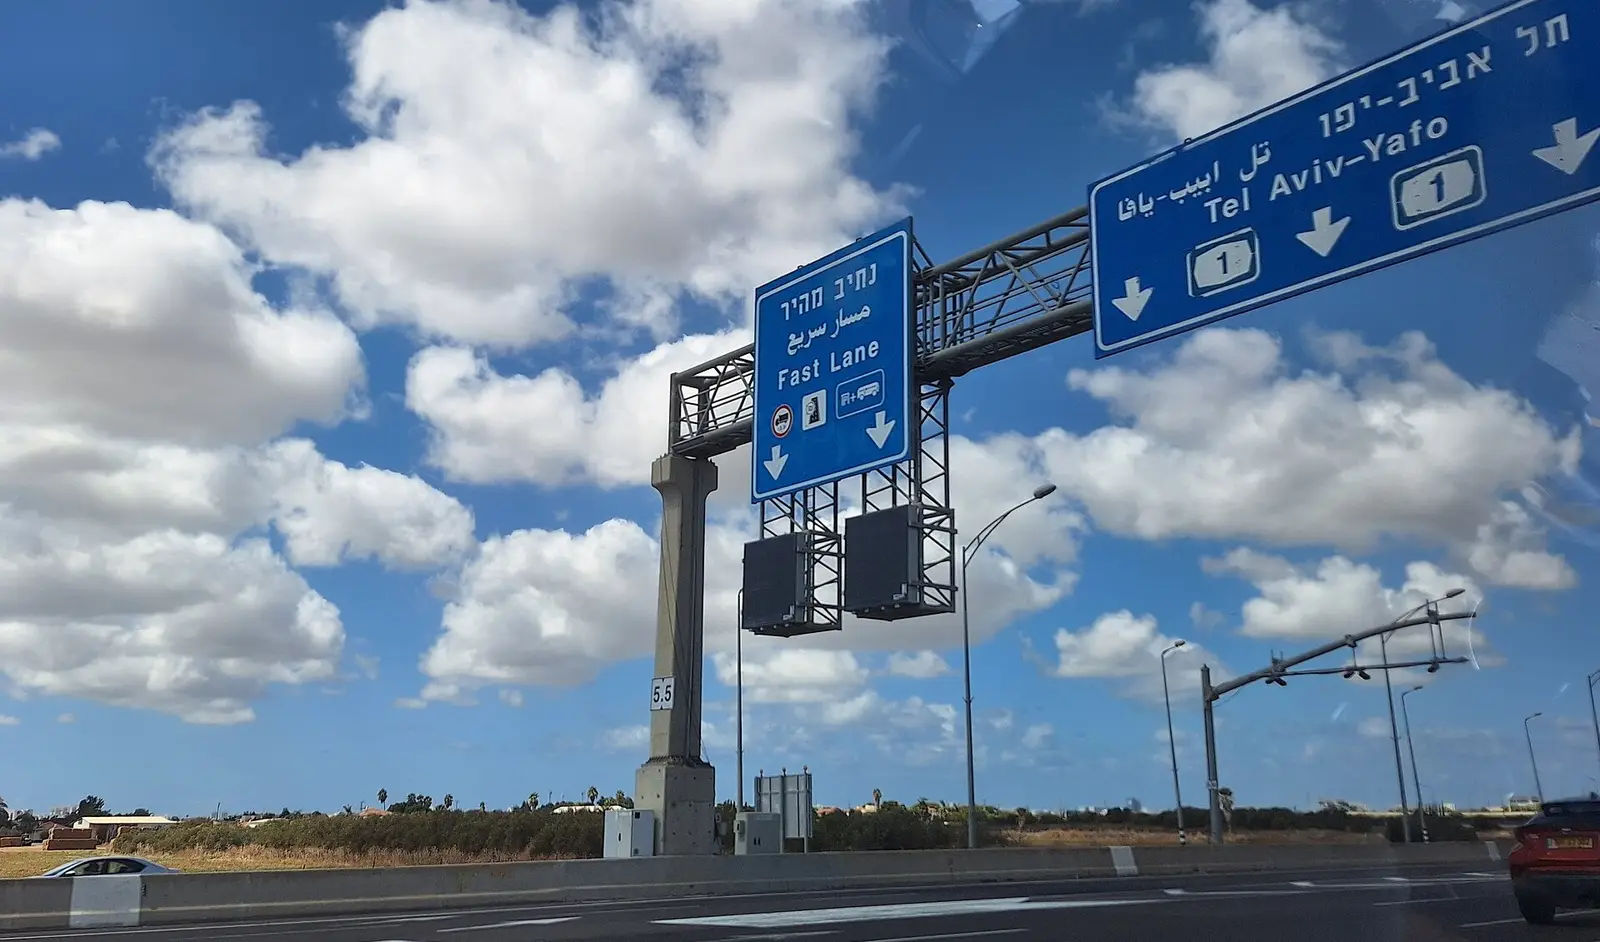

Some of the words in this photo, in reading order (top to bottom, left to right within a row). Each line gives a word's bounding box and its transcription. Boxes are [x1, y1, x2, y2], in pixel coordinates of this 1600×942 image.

[1515, 13, 1570, 57] תל
[1239, 141, 1272, 182] تل
[1429, 171, 1445, 202] 1
[1204, 187, 1250, 223] Tel
[1216, 251, 1228, 275] 1
[834, 263, 877, 300] נתיב
[780, 286, 823, 321] מהיר
[787, 322, 827, 356] سريع
[830, 305, 871, 338] مسار
[778, 359, 820, 390] Fast
[830, 340, 879, 372] Lane
[653, 684, 672, 703] 5.5
